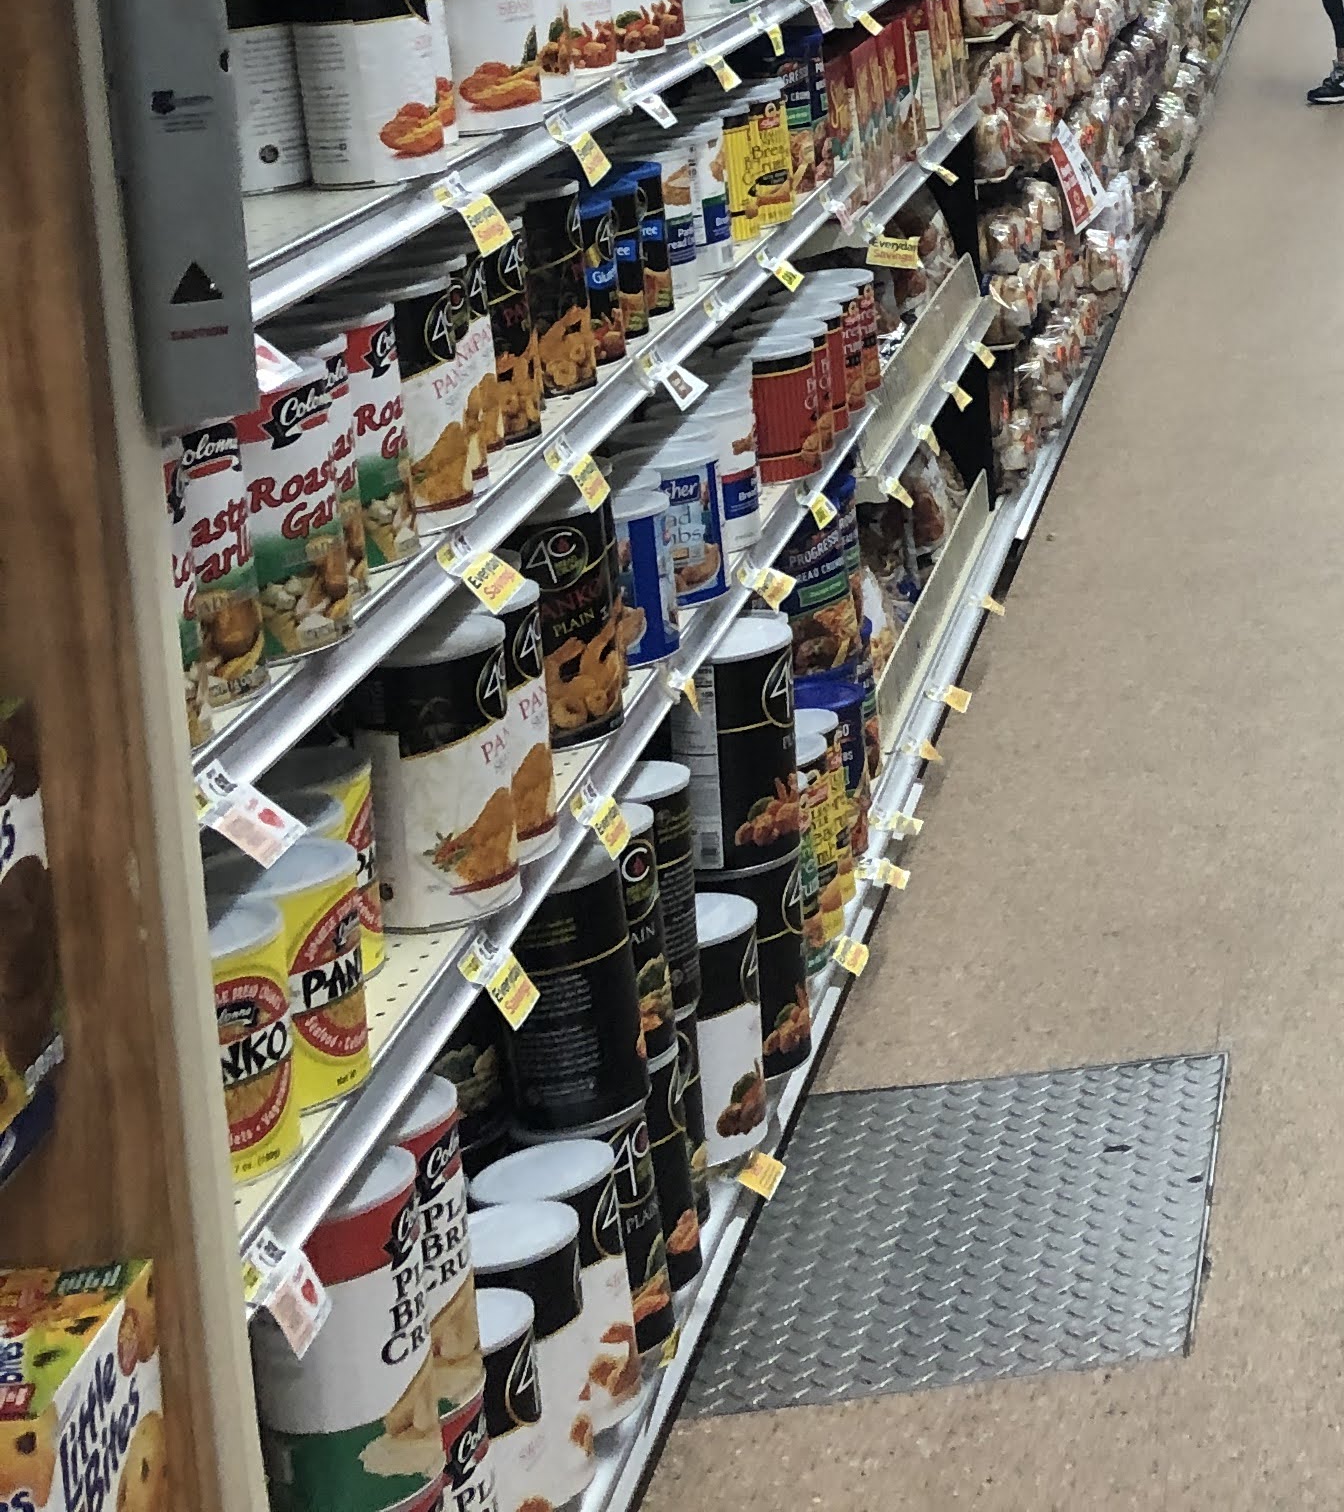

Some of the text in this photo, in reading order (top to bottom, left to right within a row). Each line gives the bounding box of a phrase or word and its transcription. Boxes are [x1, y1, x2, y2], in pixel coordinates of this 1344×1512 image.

[642, 225, 658, 237] ree
[280, 392, 333, 427] Colon
[182, 436, 239, 466] olonn
[663, 480, 699, 500] sher
[281, 492, 338, 540] Gar
[526, 531, 577, 584] 4C
[788, 532, 839, 568] PROGRESS
[552, 608, 596, 638] PLAIN
[770, 660, 791, 718] 4
[621, 846, 651, 883] C
[301, 947, 361, 1009] PAN
[221, 1020, 288, 1085] NKO
[601, 1177, 625, 1250] 4
